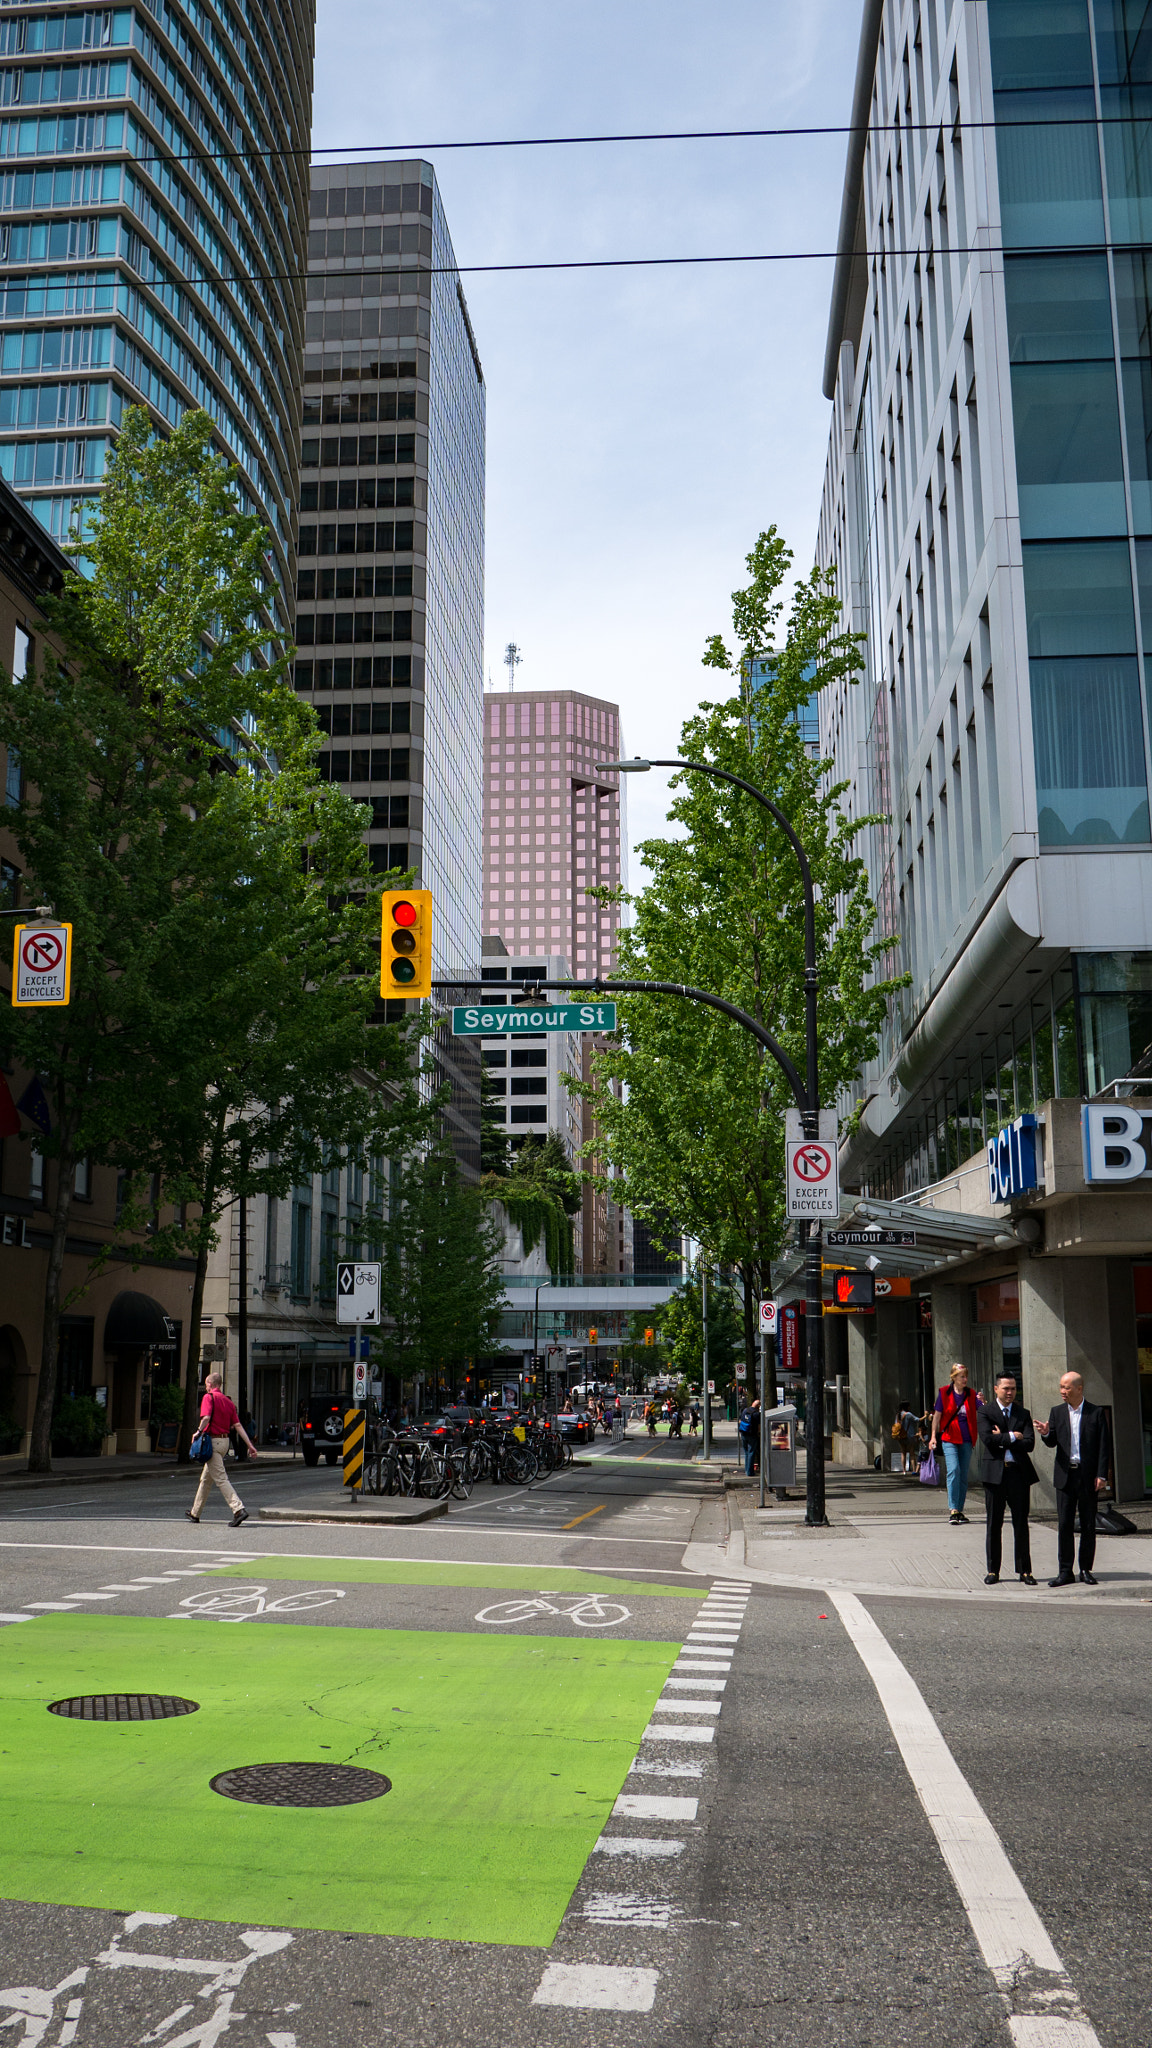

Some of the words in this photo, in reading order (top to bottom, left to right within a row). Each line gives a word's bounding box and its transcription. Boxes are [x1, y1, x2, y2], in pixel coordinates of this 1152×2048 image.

[25, 976, 58, 986] EXCEPT
[20, 987, 62, 997] BICYCLES
[464, 1009, 567, 1030] Seymour
[579, 1006, 605, 1025] St
[987, 1114, 1036, 1204] BCIT
[796, 1188, 829, 1198] EXCEPT
[792, 1201, 833, 1210] BICYCLES
[2, 1216, 33, 1248] EL
[830, 1232, 882, 1245] Seymour
